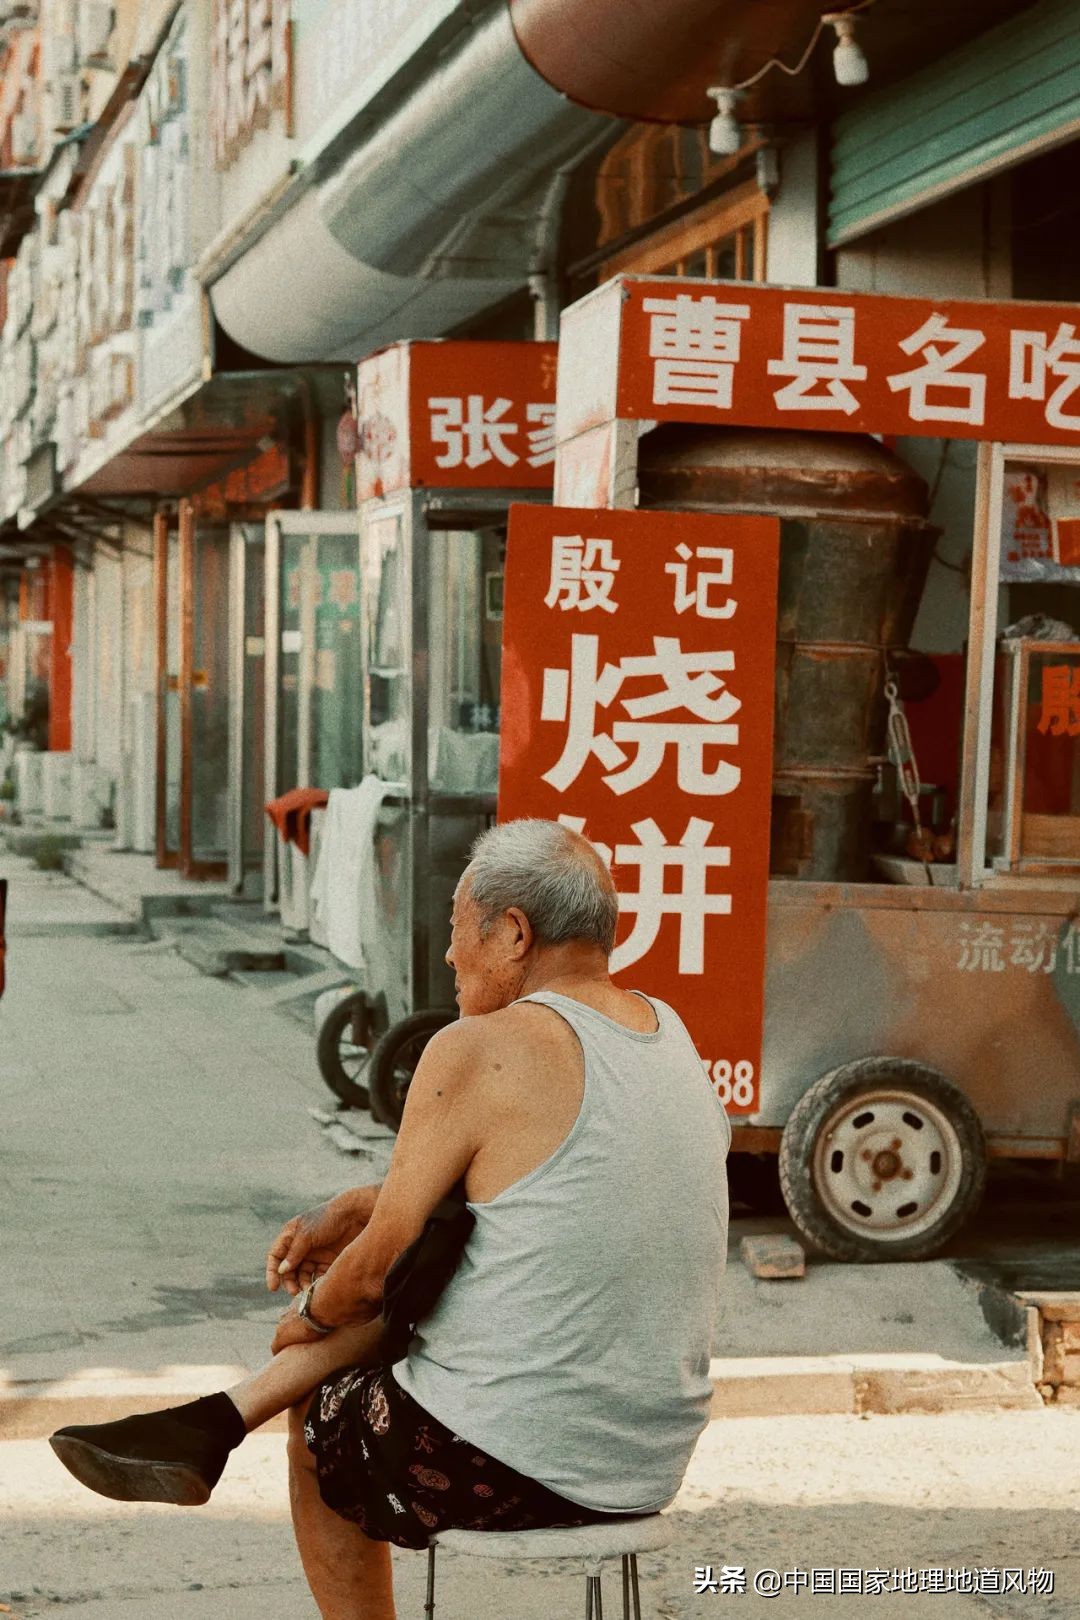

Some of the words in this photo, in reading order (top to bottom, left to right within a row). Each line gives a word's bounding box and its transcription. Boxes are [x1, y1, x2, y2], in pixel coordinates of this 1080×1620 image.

[643, 294, 1080, 431] 曹县名吃
[543, 535, 738, 620] 殷记
